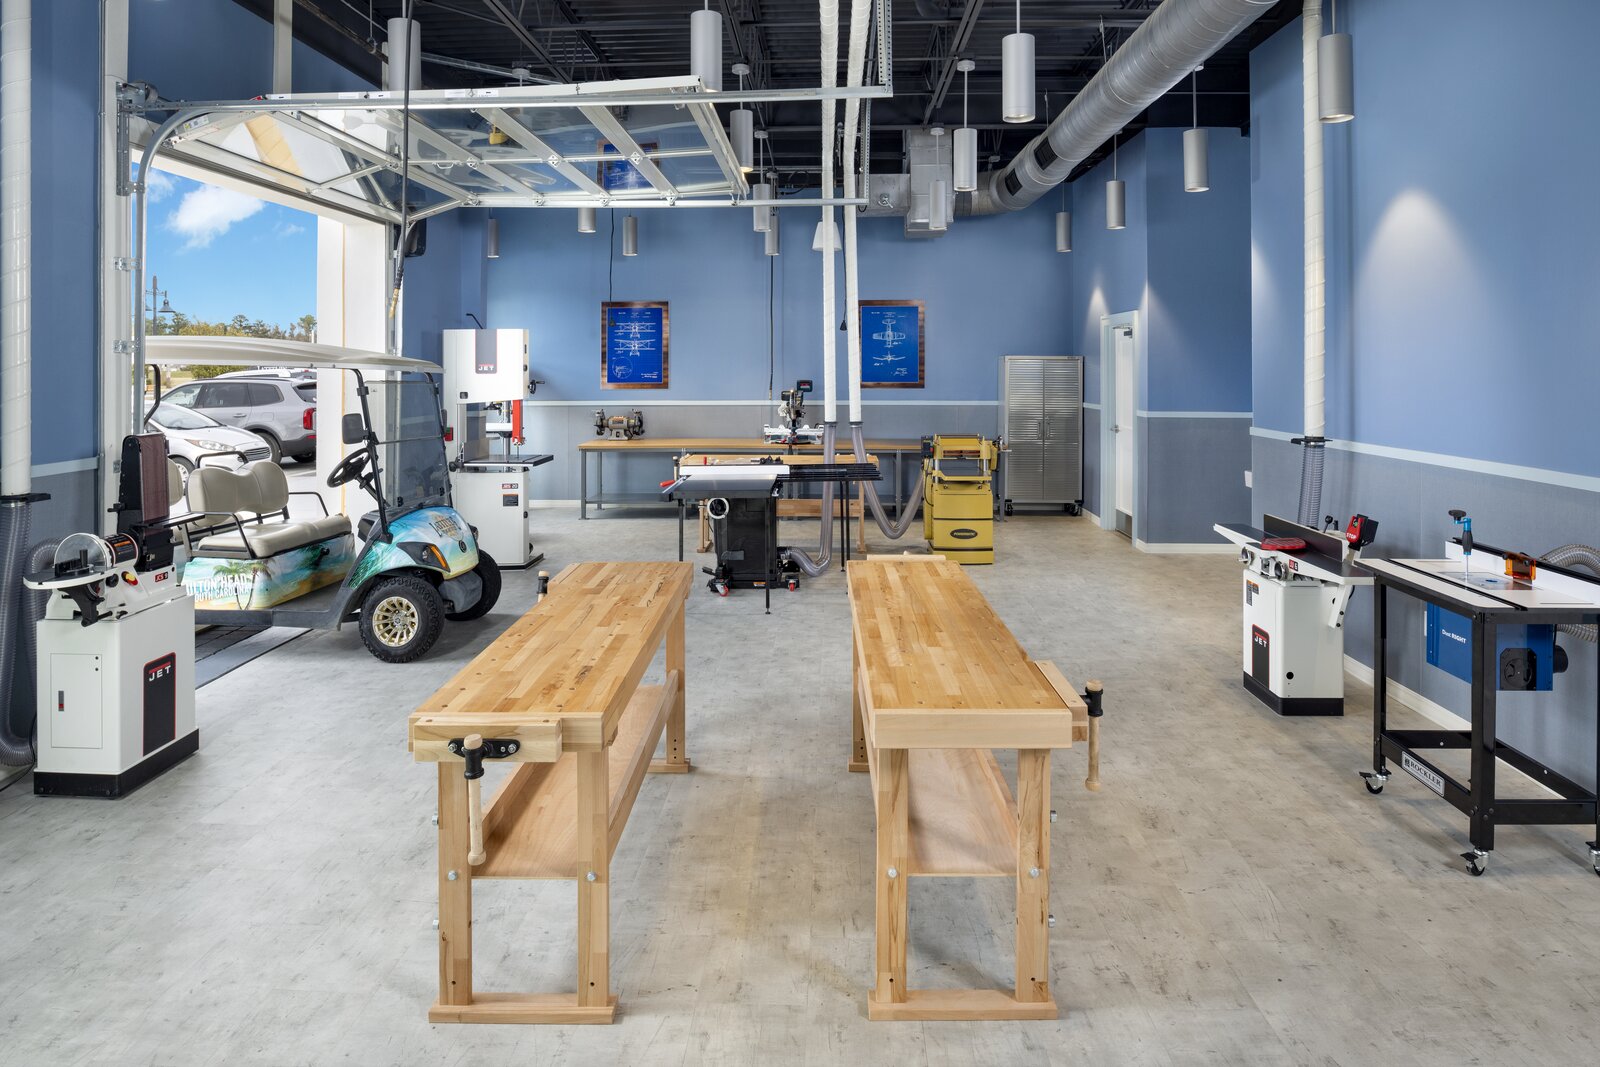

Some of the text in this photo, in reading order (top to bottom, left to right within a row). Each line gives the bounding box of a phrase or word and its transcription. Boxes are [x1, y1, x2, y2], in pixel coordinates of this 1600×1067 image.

[220, 574, 246, 588] HEAD
[194, 584, 251, 602] OUTH CAROLINA
[1254, 636, 1268, 647] JET
[149, 665, 171, 682] JET
[1410, 761, 1441, 787] ROCKLER
